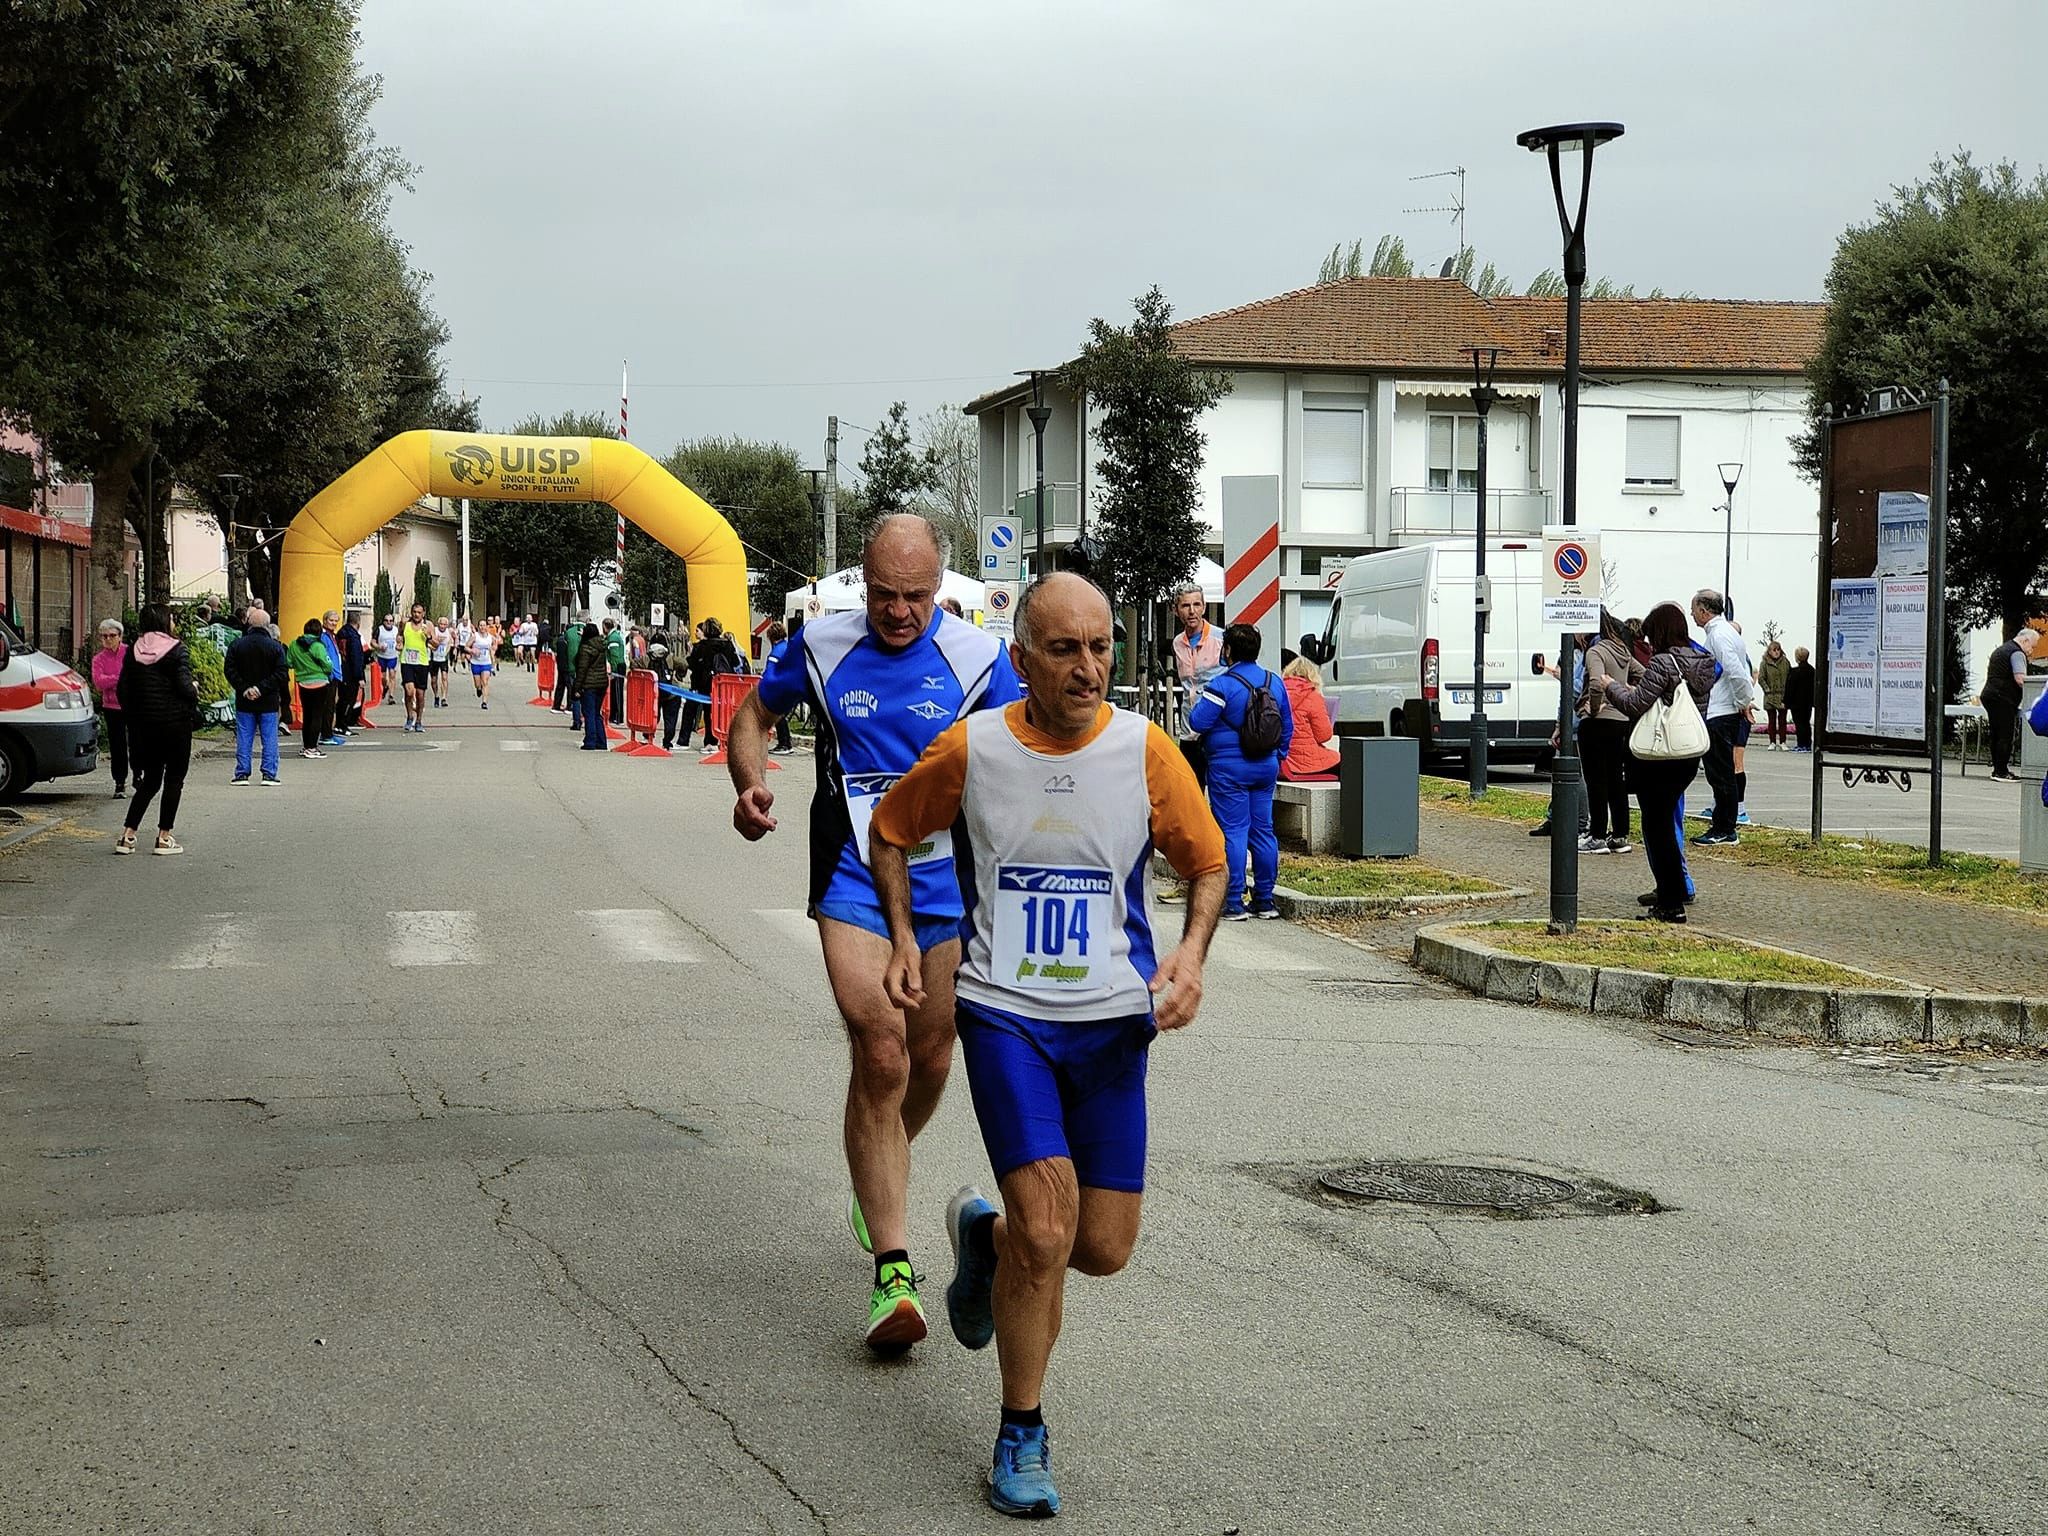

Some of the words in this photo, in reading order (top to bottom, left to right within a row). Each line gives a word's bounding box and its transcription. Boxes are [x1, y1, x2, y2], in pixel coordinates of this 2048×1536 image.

[501, 446, 580, 474] UISP
[500, 474, 536, 484] UNIONE
[540, 475, 580, 485] ITALIANA
[501, 483, 529, 491] SPORT
[1881, 524, 1901, 544] Ivan
[1903, 521, 1927, 543] Alvisi
[1886, 584, 1926, 593] RINGRAZIAMENTO
[1903, 602, 1925, 613] NATALIA
[1835, 661, 1874, 670] RINGRAZIAMENTO
[1883, 661, 1923, 670] RINGRAZIAMENTO
[1833, 676, 1856, 689] ALVISI
[1857, 677, 1873, 689] IVAN
[1899, 680, 1923, 689] ANSELMO
[839, 689, 878, 712] PODISTICA
[1022, 896, 1090, 957] 104
